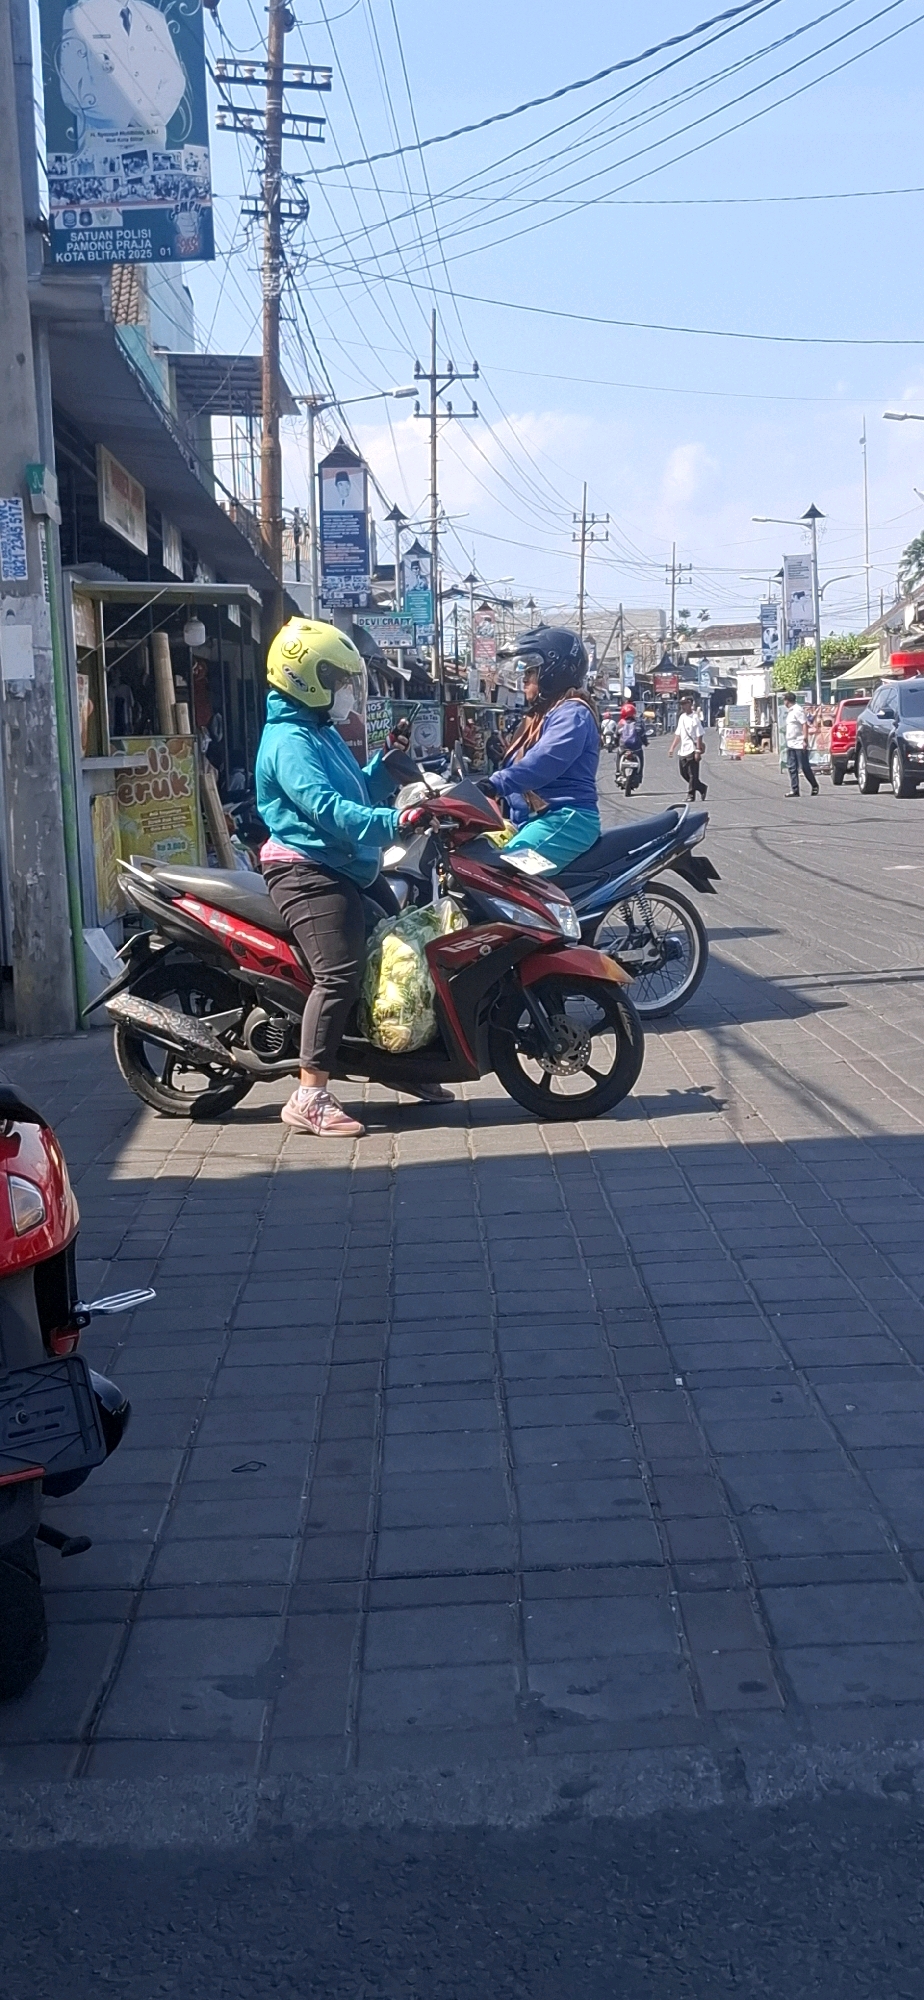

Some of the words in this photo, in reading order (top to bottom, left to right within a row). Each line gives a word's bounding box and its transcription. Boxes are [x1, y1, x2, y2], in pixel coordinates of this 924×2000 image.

[70, 230, 113, 242] SATUAN
[116, 229, 152, 240] POLISI
[66, 241, 113, 252] PAMONG
[115, 239, 152, 250] PRAJA
[160, 247, 171, 256] 01
[55, 251, 86, 263] KOTA
[88, 250, 126, 261] BLITAR
[128, 249, 153, 259] 2025
[8, 499, 22, 523] 5174
[12, 554, 27, 577] 0821
[359, 618, 380, 626] DEVI
[367, 702, 382, 712] IOS
[366, 718, 391, 733] AYUR
[117, 771, 191, 806] eruk
[438, 932, 503, 953] 125
